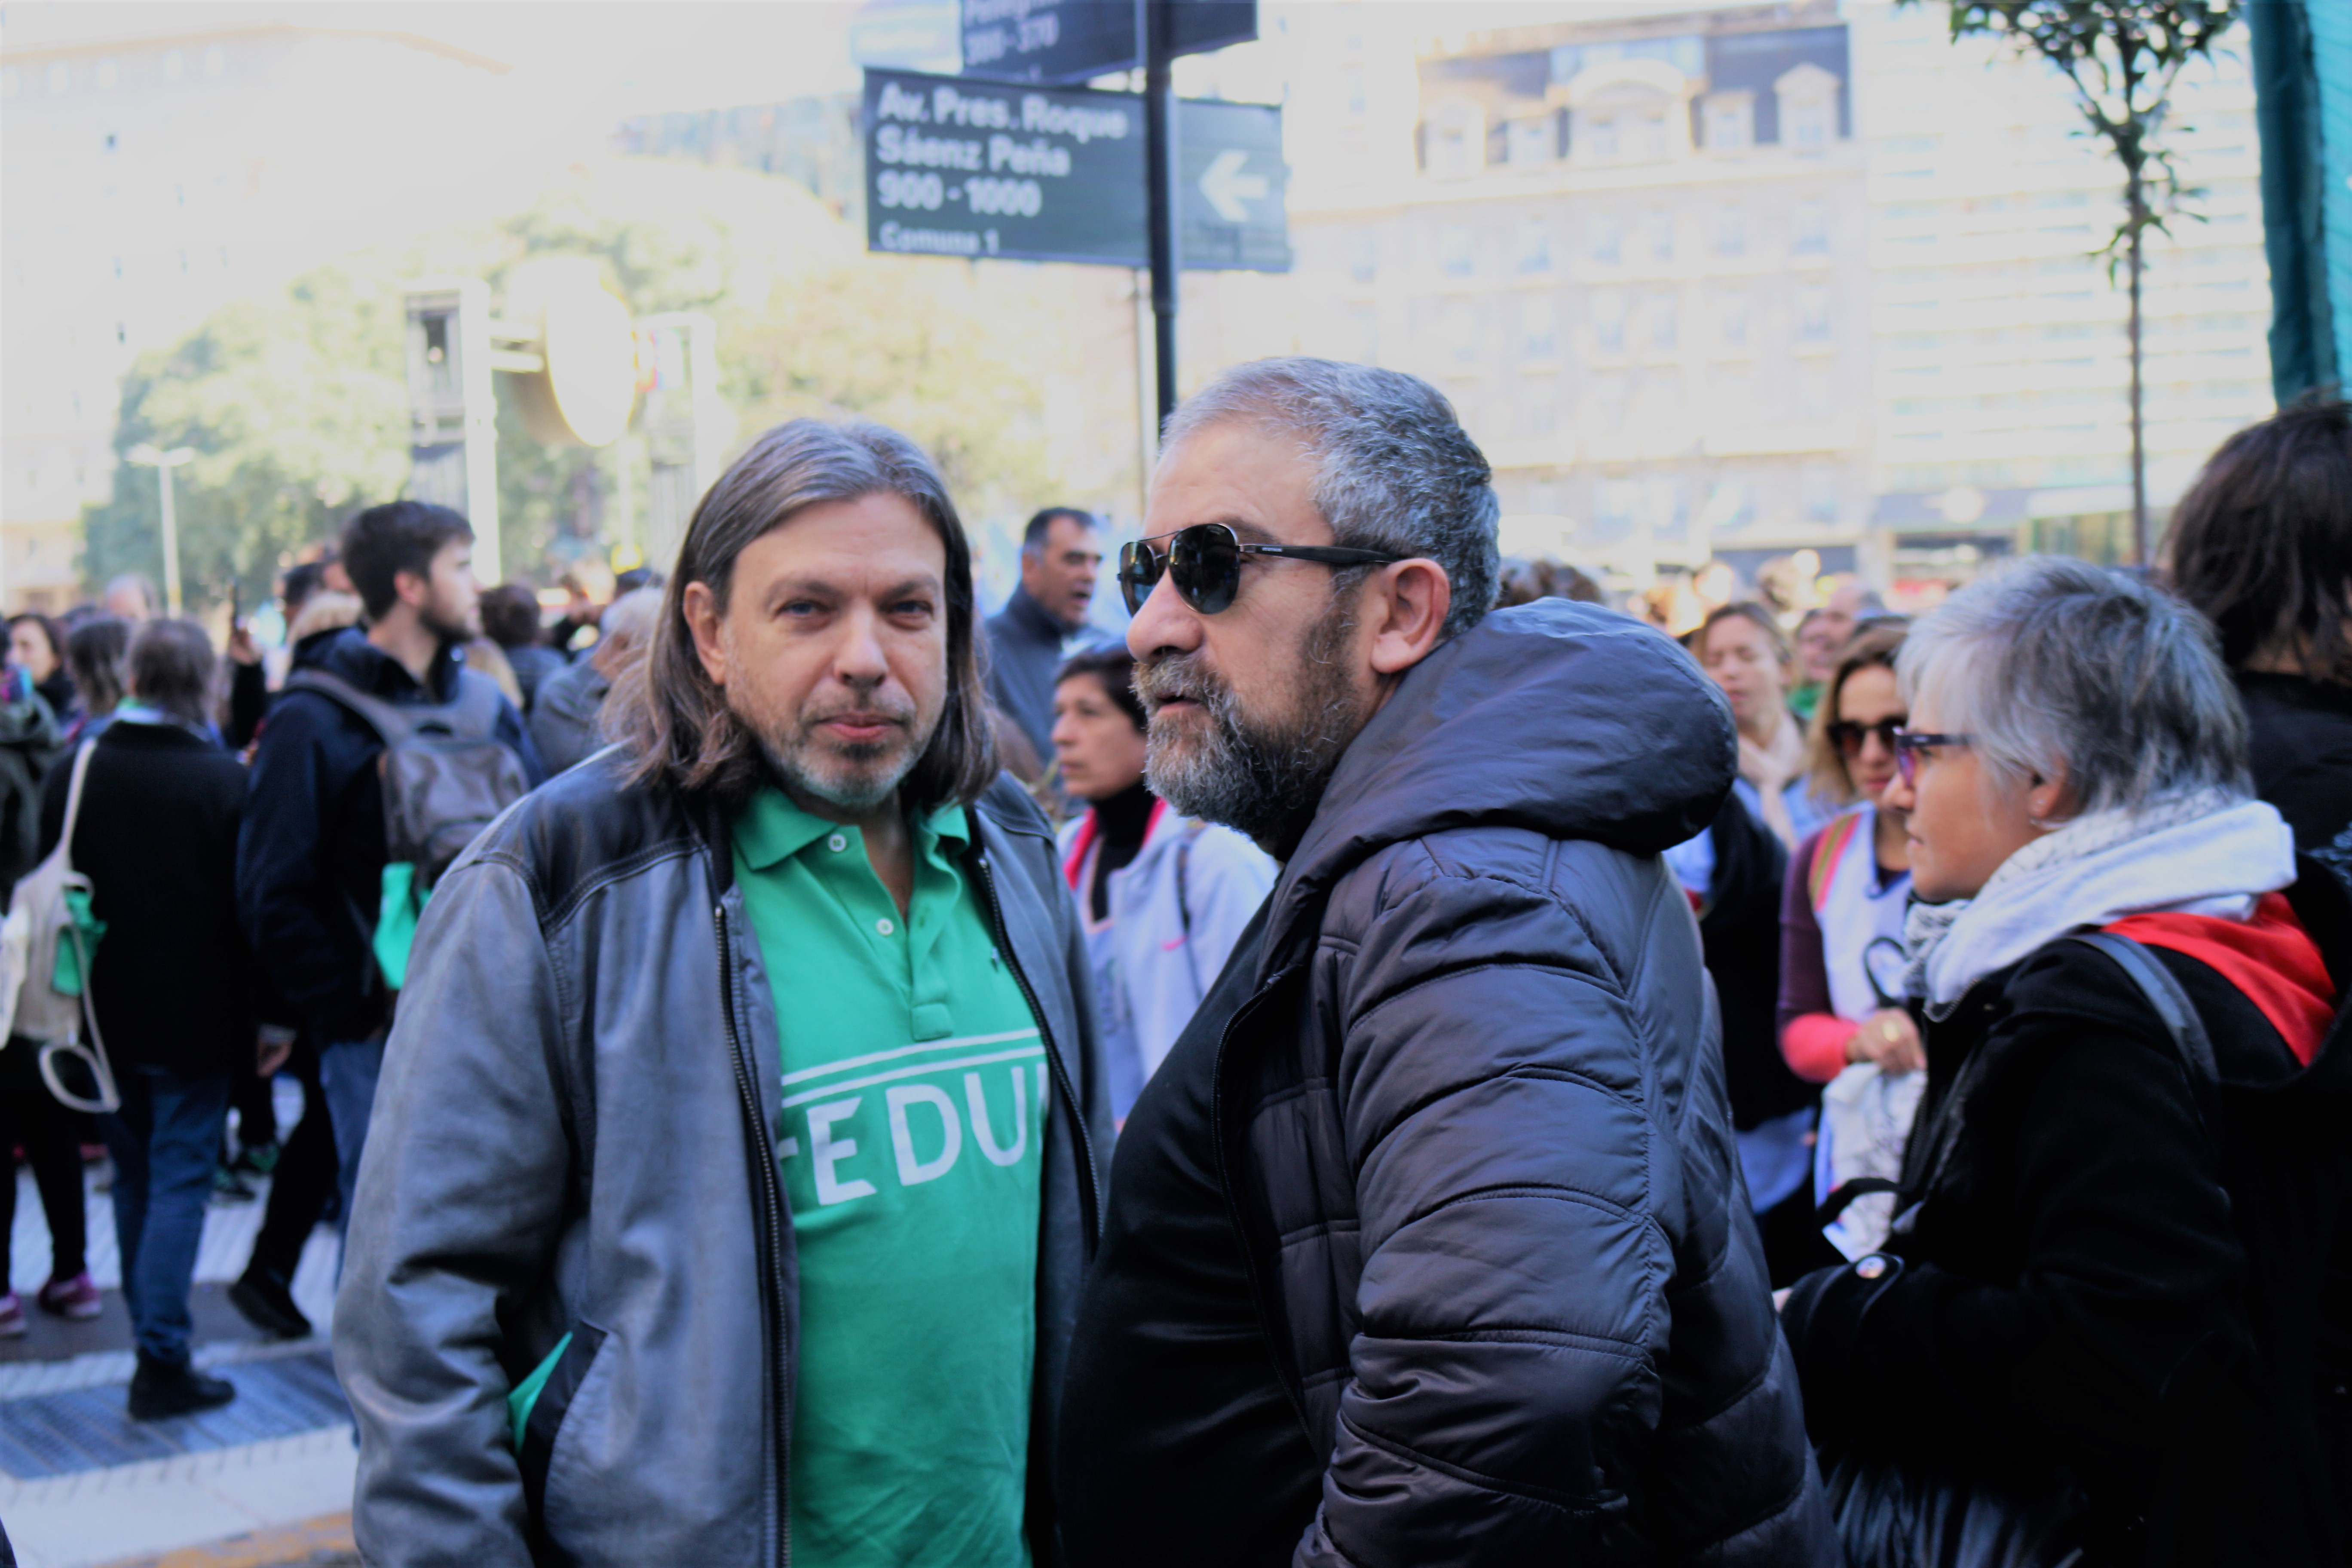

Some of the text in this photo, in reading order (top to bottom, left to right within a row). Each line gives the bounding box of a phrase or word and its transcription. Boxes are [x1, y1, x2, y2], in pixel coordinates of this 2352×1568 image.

[879, 84, 1127, 143] Av. Pres. Roque
[878, 125, 1070, 177] Sáenz Peña
[878, 171, 943, 209] 900
[964, 177, 1042, 217] 1000
[881, 222, 999, 255] Comuna 1
